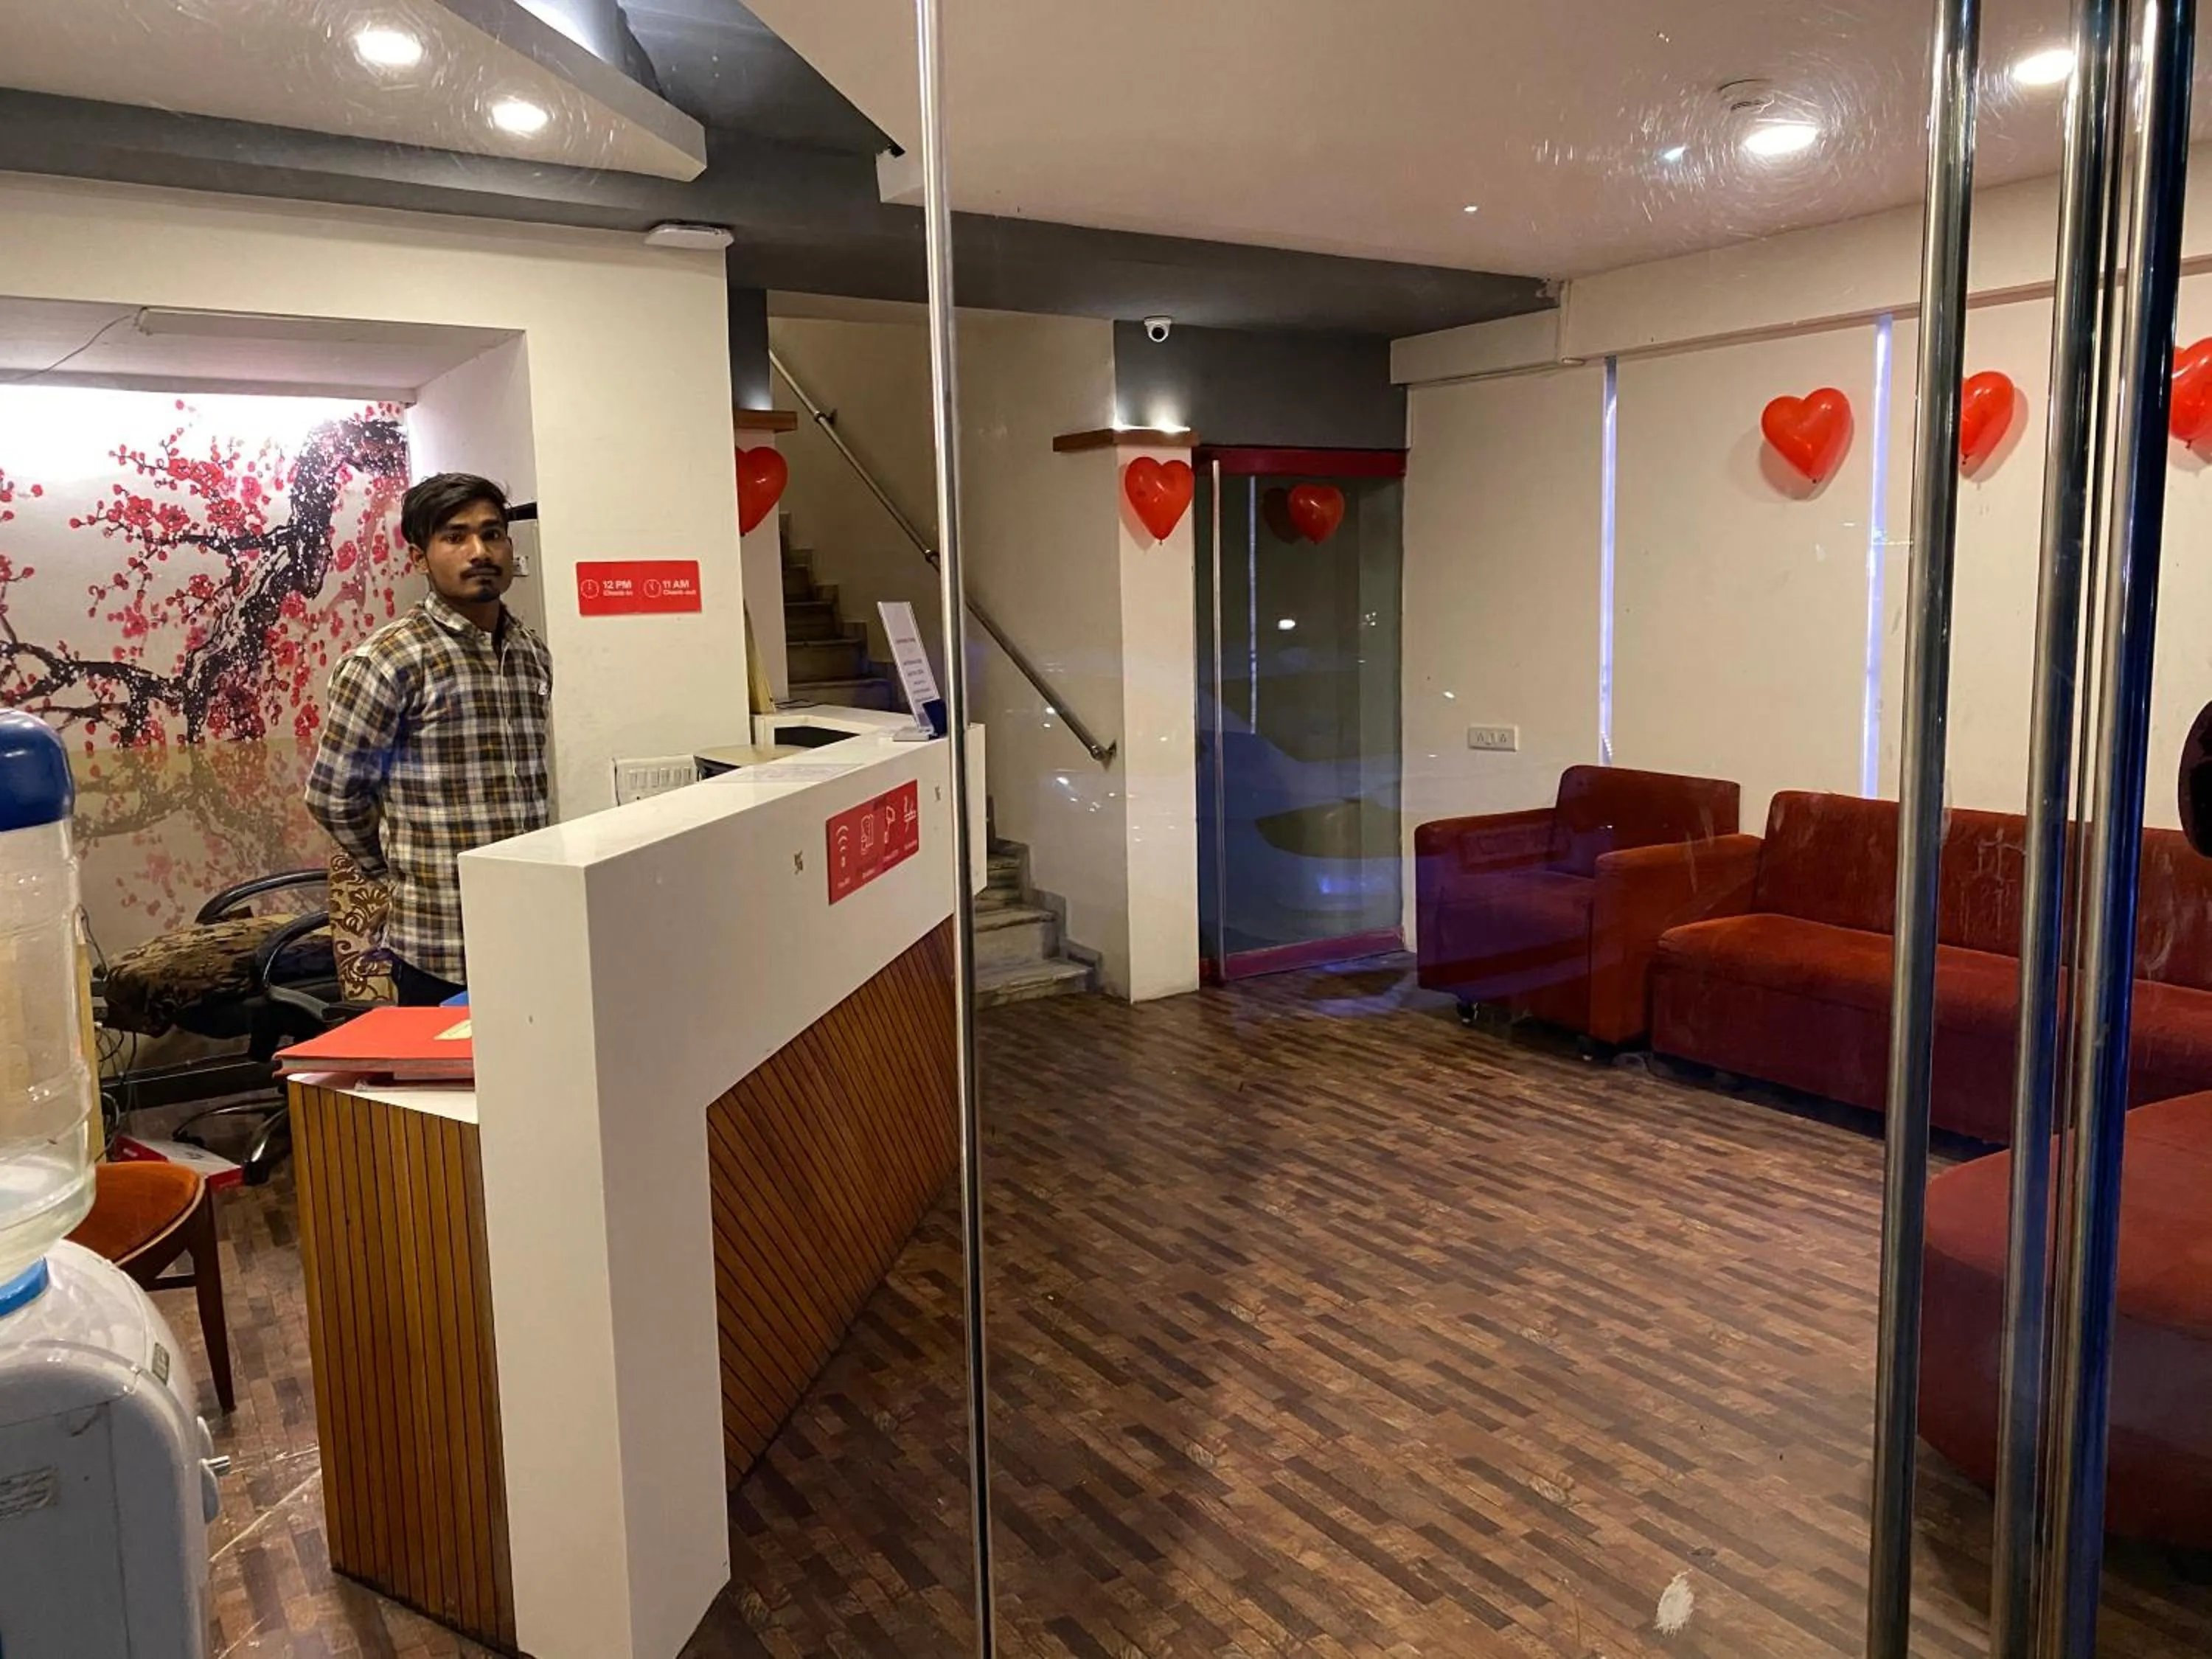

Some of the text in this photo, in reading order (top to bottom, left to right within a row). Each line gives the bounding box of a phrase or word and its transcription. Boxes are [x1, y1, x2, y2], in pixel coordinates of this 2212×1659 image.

[602, 580, 632, 589] 12 PM
[662, 580, 689, 588] 11 AM
